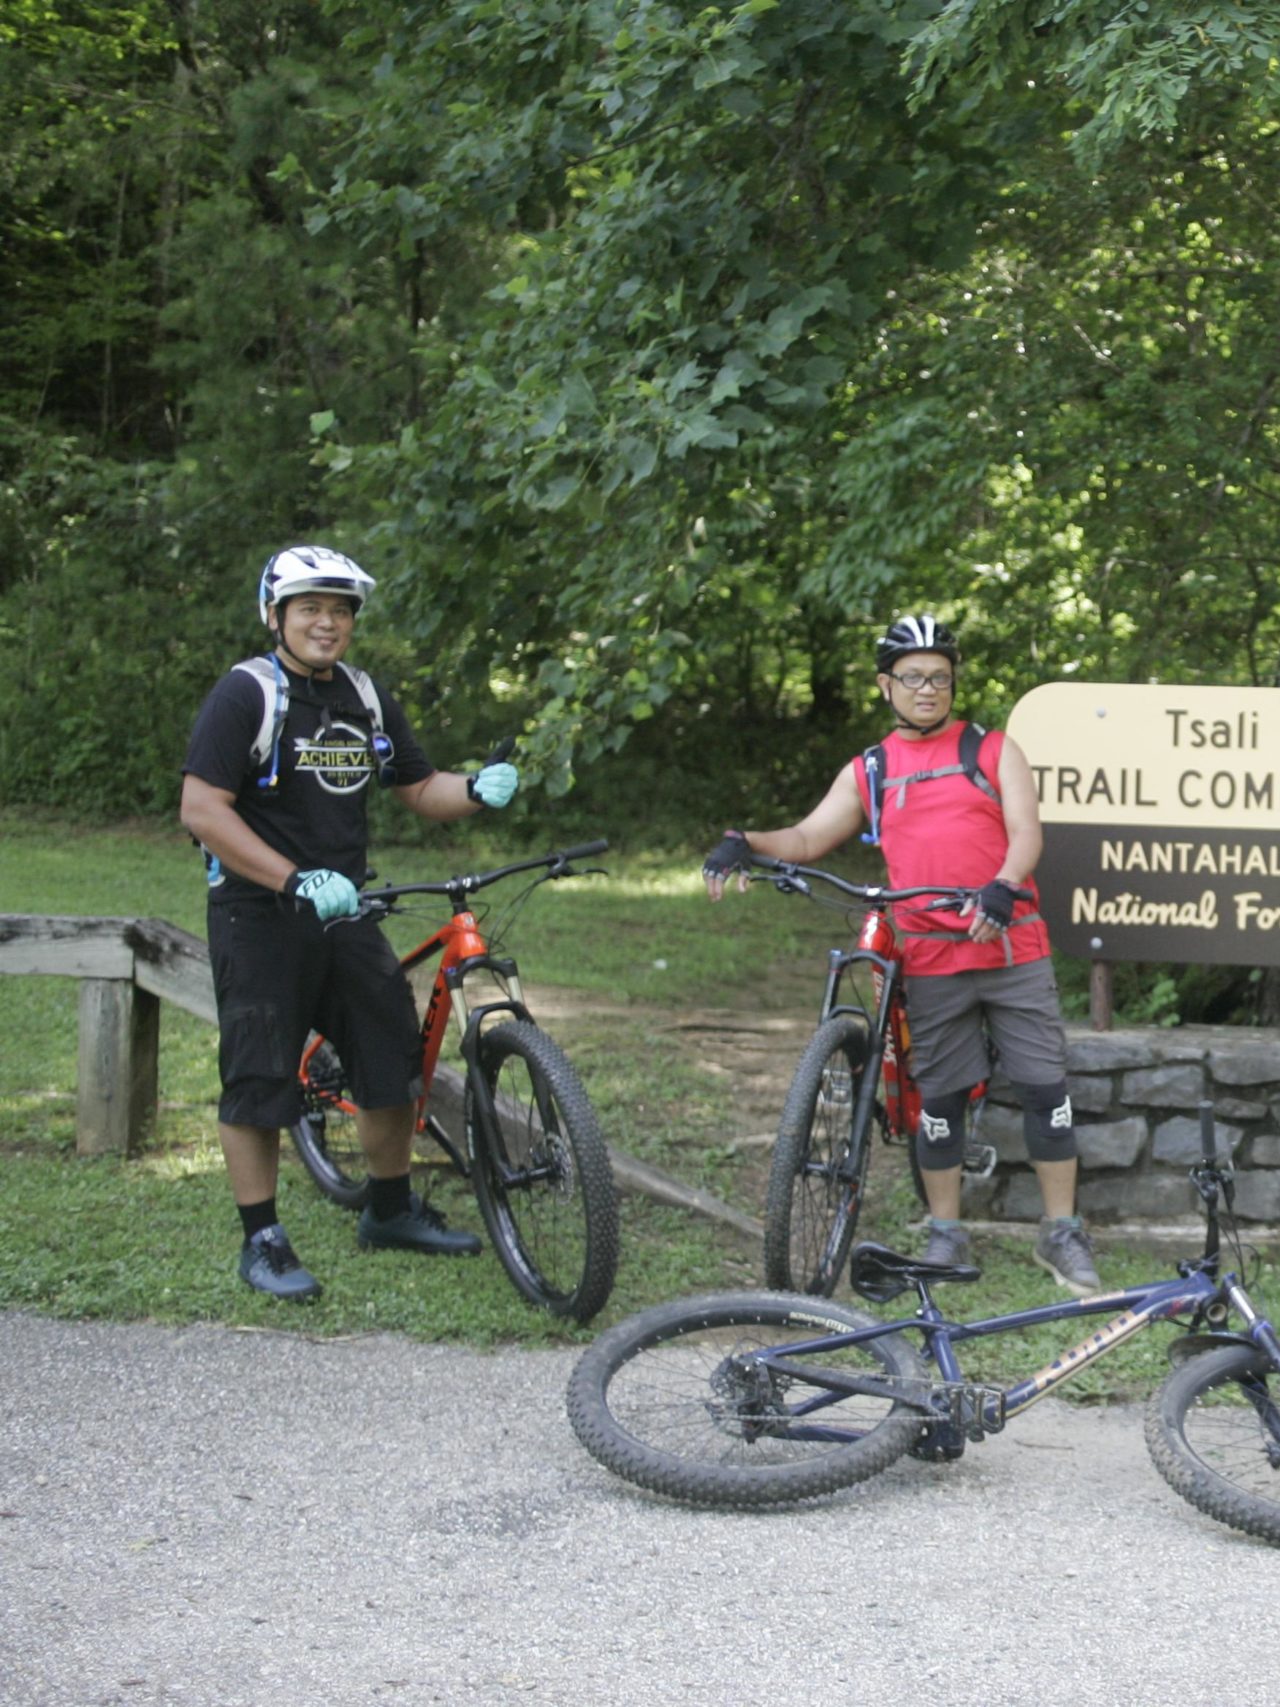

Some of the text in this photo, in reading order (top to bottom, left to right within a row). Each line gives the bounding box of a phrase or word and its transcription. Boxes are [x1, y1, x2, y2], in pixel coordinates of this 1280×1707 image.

[1164, 709, 1260, 750] Tsali
[1031, 765, 1158, 807] TRAIL
[1072, 886, 1219, 929] National
